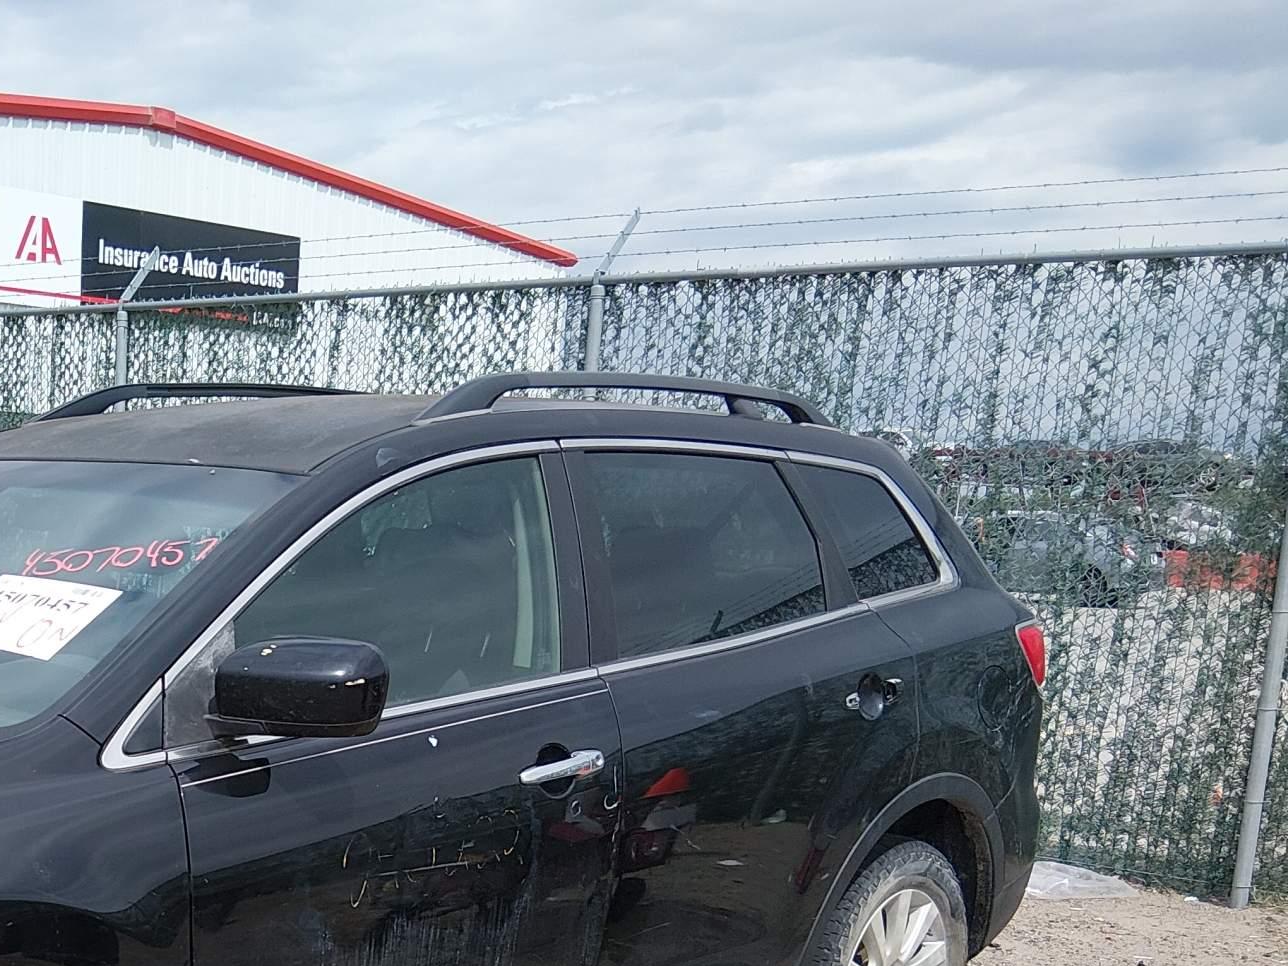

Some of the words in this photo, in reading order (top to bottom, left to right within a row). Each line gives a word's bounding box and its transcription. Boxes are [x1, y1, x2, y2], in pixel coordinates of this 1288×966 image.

[181, 251, 217, 280] Auto
[220, 257, 285, 289] Auctions
[22, 536, 222, 576] 45070457
